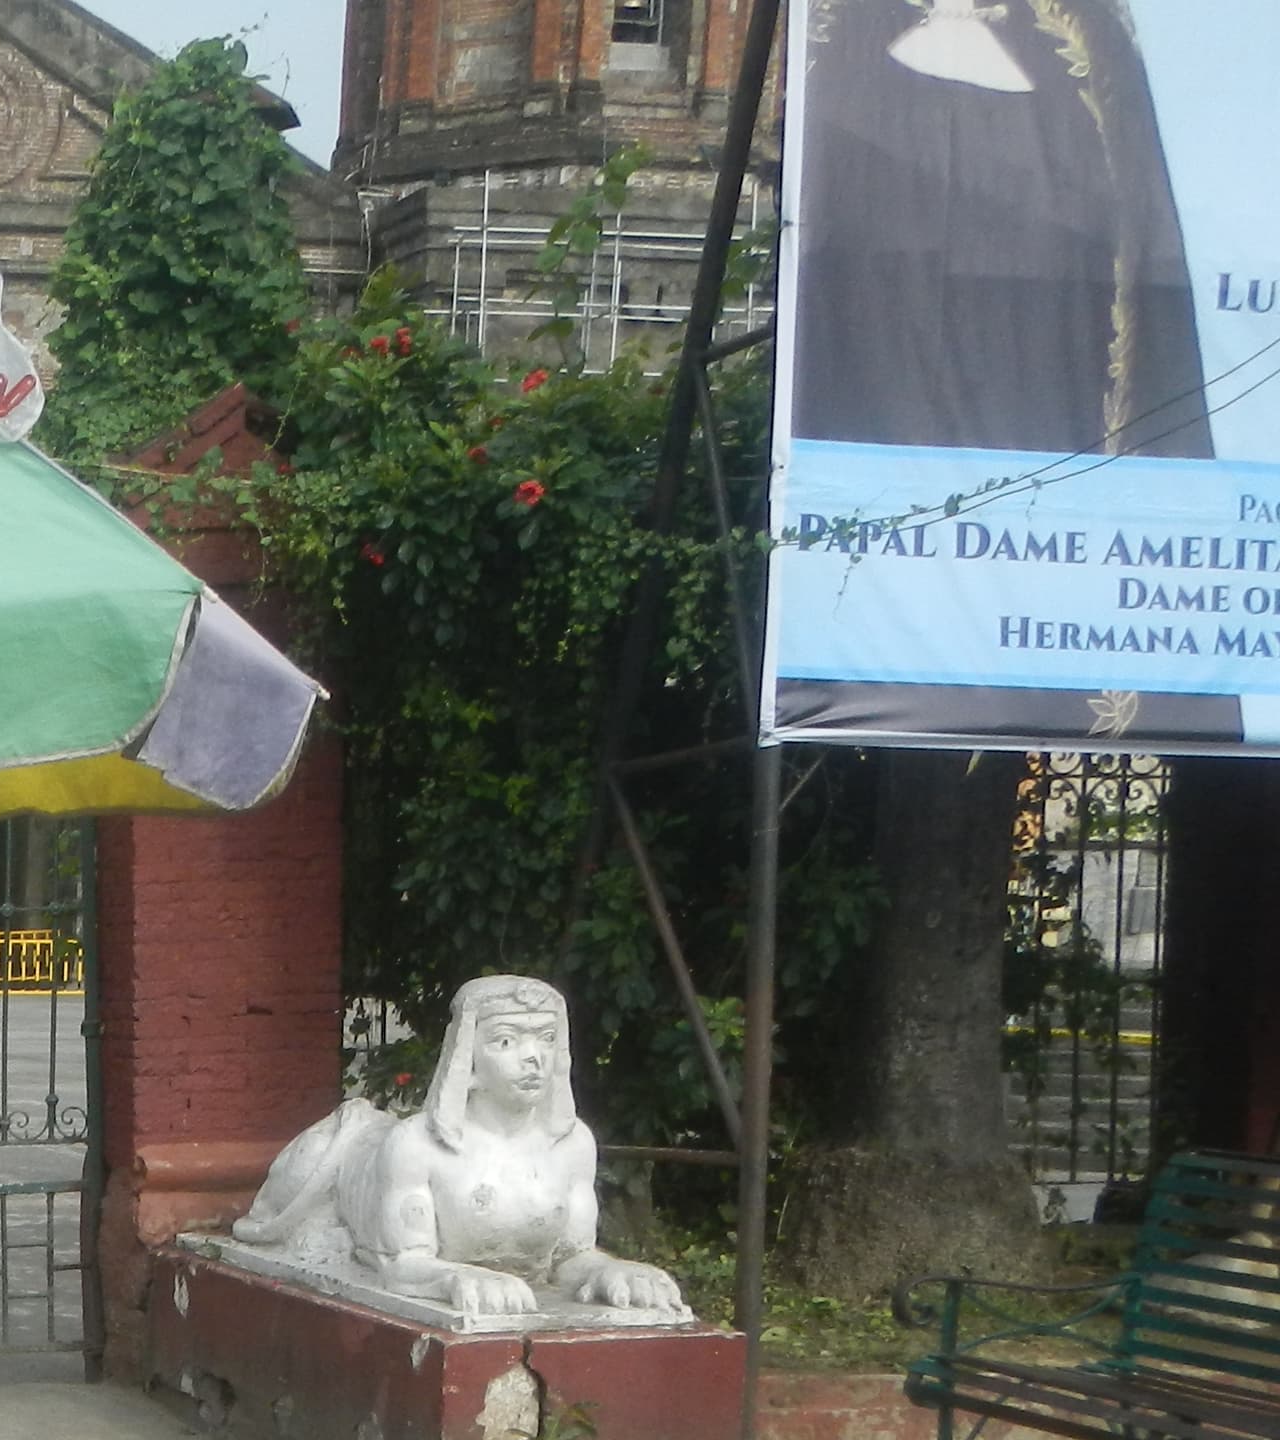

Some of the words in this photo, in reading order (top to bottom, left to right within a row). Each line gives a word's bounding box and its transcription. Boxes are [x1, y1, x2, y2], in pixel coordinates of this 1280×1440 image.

[797, 513, 937, 558] PAPAL
[954, 521, 1088, 564] DAME
[1117, 577, 1231, 613] DAME
[998, 615, 1199, 656] HERMANA
